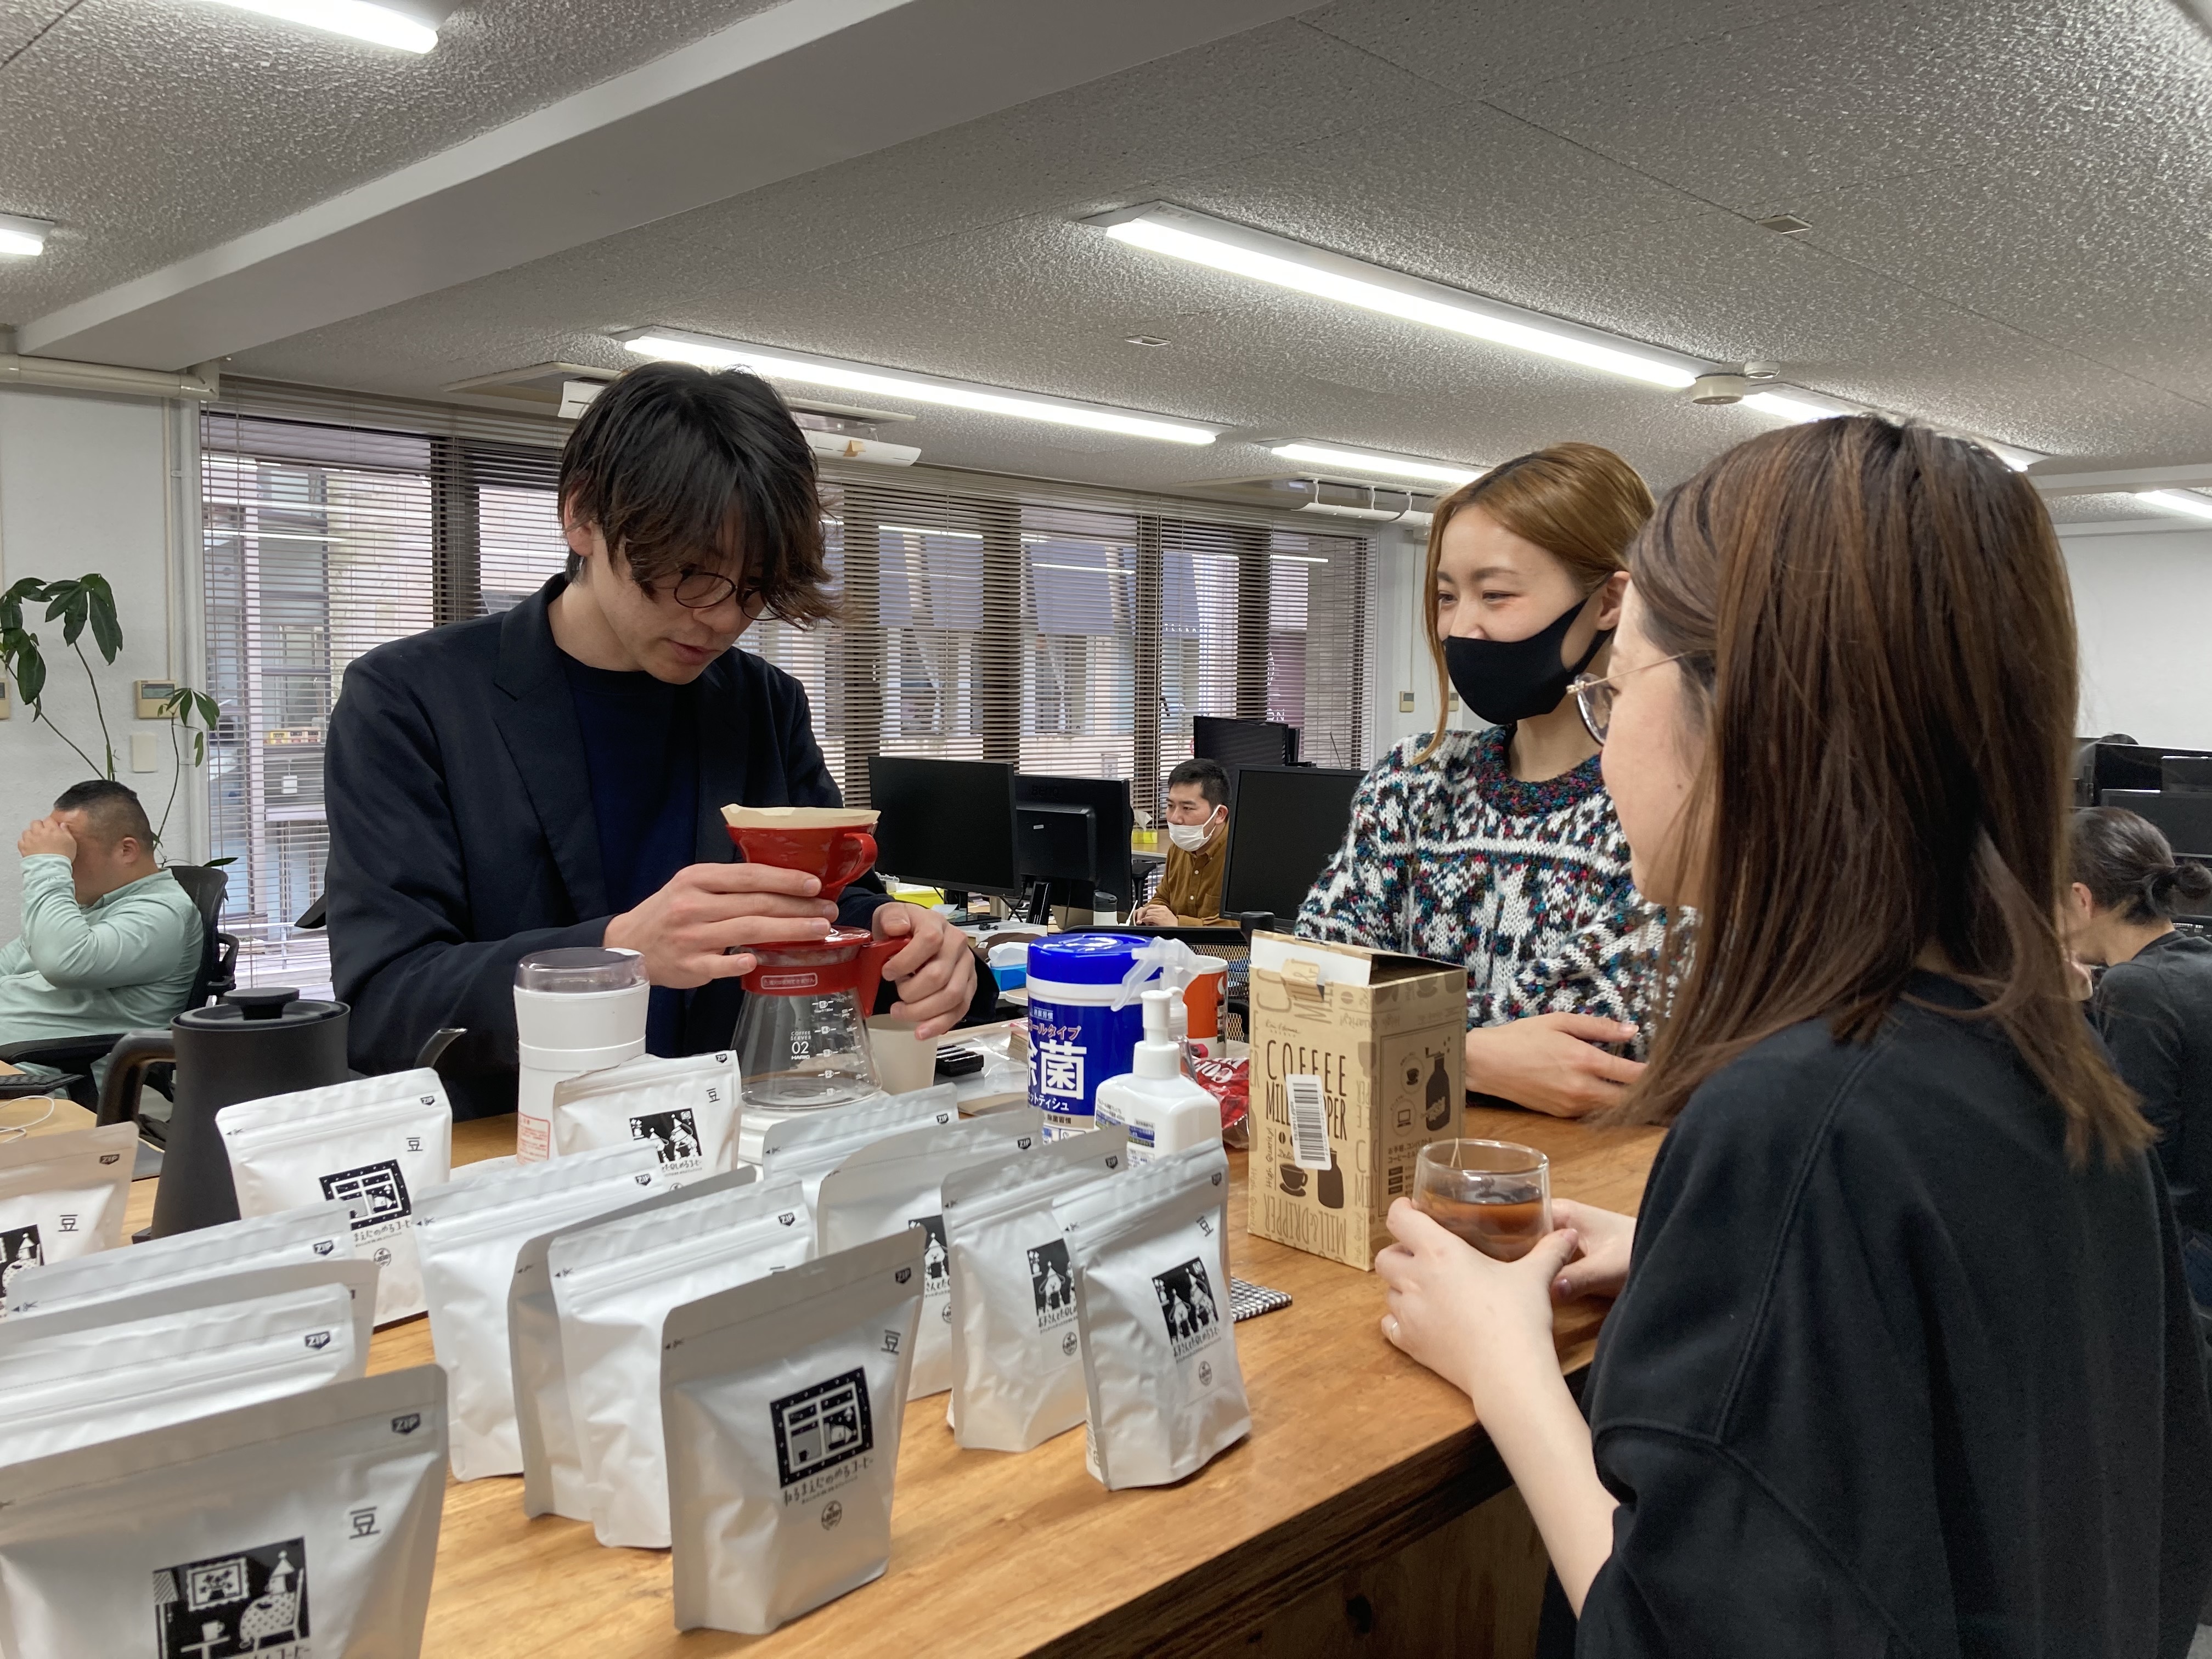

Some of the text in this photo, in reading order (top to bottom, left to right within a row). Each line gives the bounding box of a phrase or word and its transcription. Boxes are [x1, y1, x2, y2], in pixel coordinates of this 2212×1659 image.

[792, 1041, 809, 1054] 02
[1267, 1040, 1346, 1096] COFFEE
[706, 1088, 720, 1103] 豆
[406, 1137, 424, 1152] 豆
[100, 1155, 119, 1164] ZIP
[59, 1214, 79, 1232] 豆
[1197, 1216, 1214, 1237] 豆
[314, 1241, 333, 1254] ZIP
[306, 1333, 330, 1348] ZIP
[882, 1330, 901, 1355] 豆
[393, 1415, 419, 1433] ZIP
[349, 1506, 380, 1539] 豆
